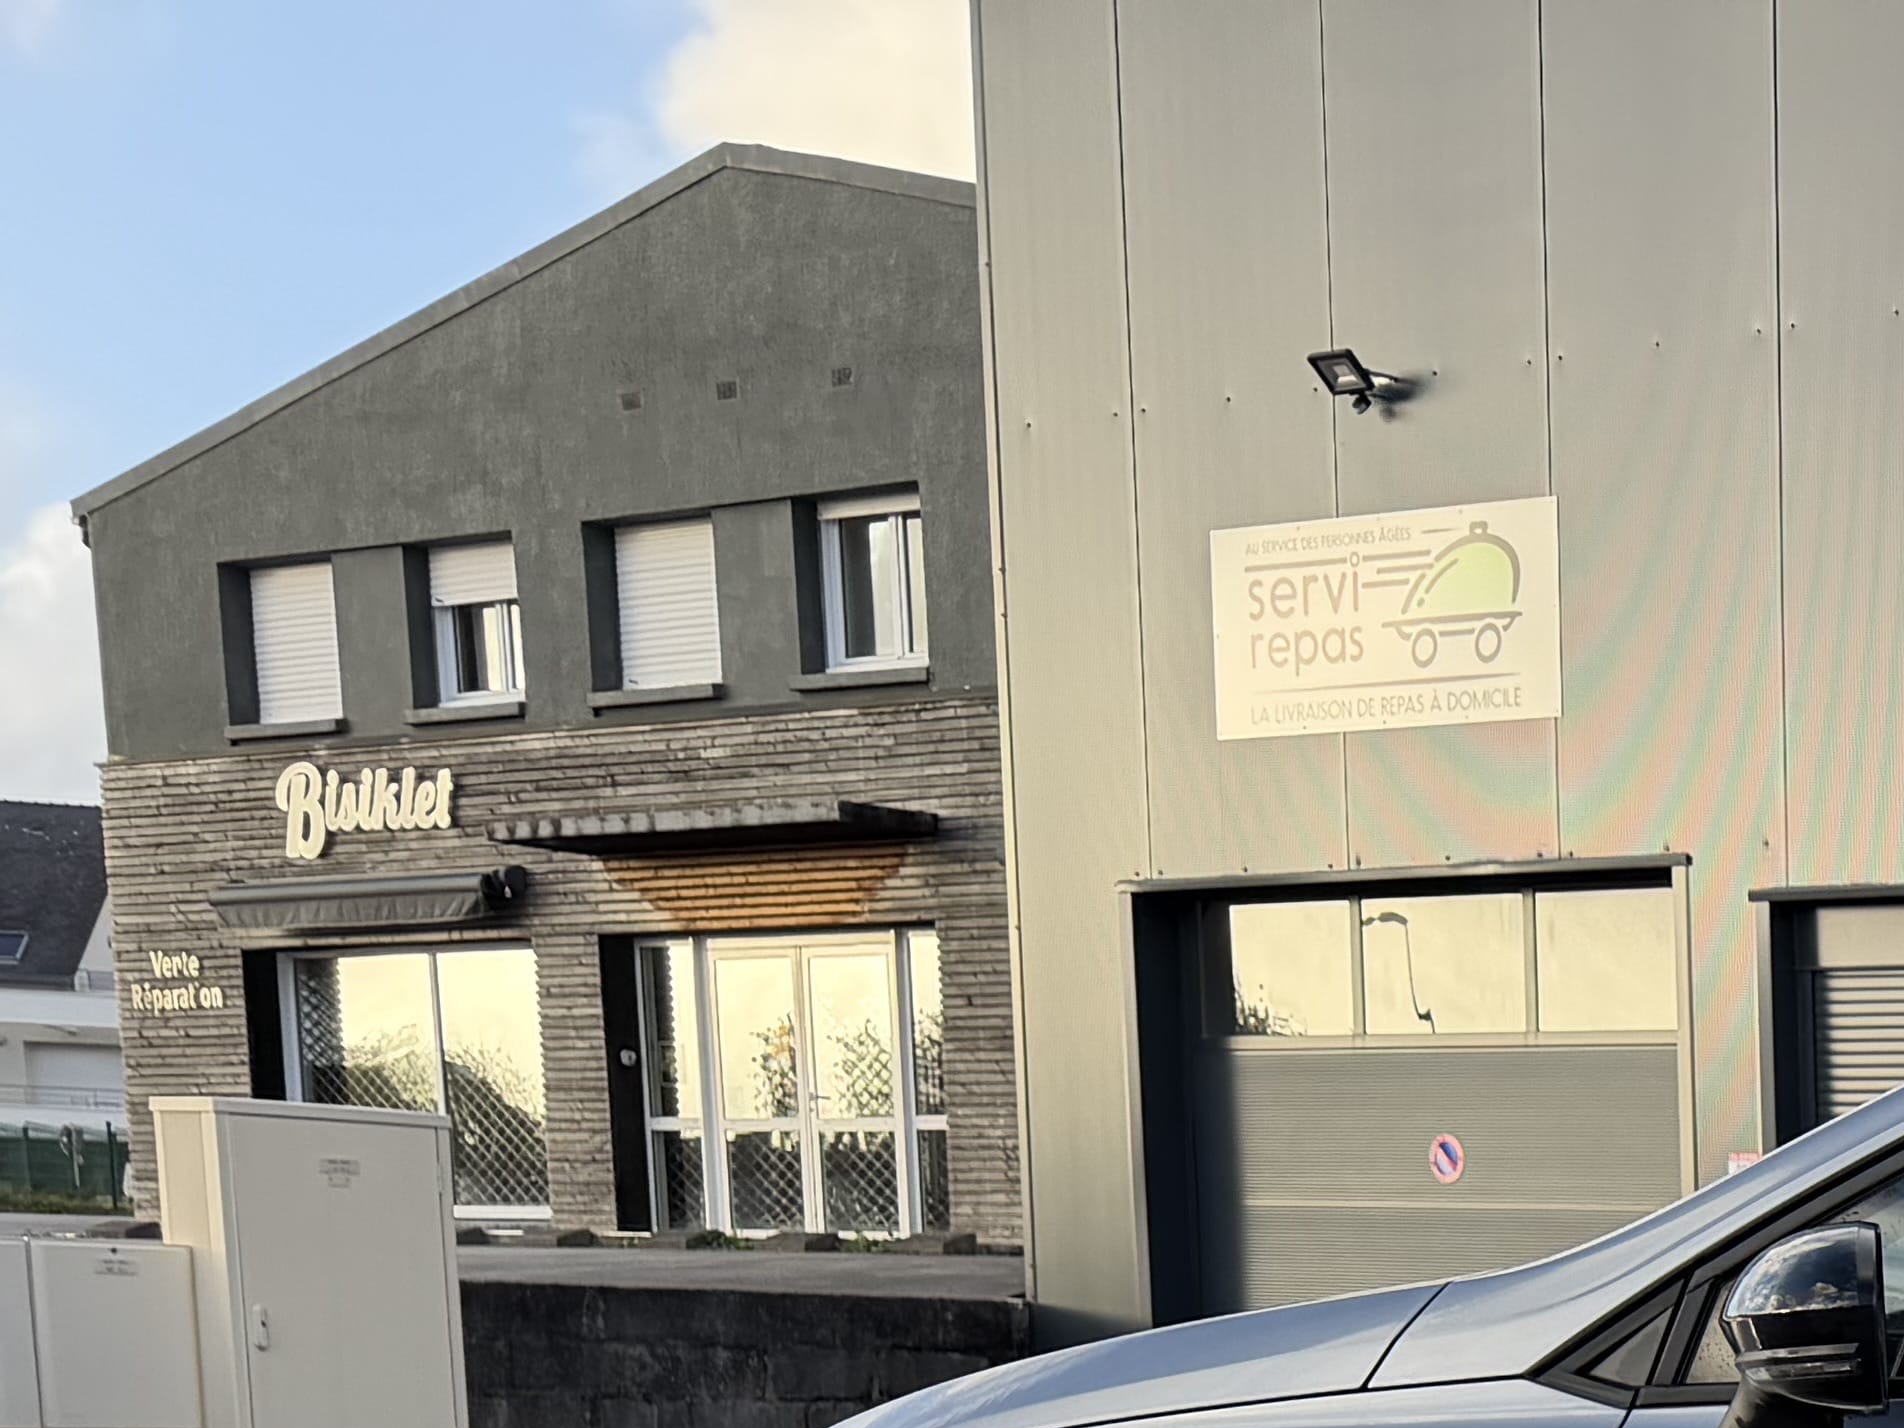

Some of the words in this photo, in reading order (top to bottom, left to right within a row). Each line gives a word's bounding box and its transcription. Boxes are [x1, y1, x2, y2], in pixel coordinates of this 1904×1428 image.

[1261, 537, 1298, 555] SERVICE
[1301, 535, 1319, 551] DES
[1321, 530, 1375, 549] PERSONNES
[1248, 551, 1360, 622] servi
[1250, 624, 1365, 677] repas
[1250, 706, 1270, 726] LA
[1274, 699, 1353, 725] LIVRAISON
[1356, 697, 1375, 718] DE
[1381, 693, 1424, 716] REPAS
[1430, 687, 1443, 713] À
[1446, 686, 1522, 712] DOMICILE
[275, 761, 454, 860] Bisiklet
[131, 981, 223, 1017] Réparaton
